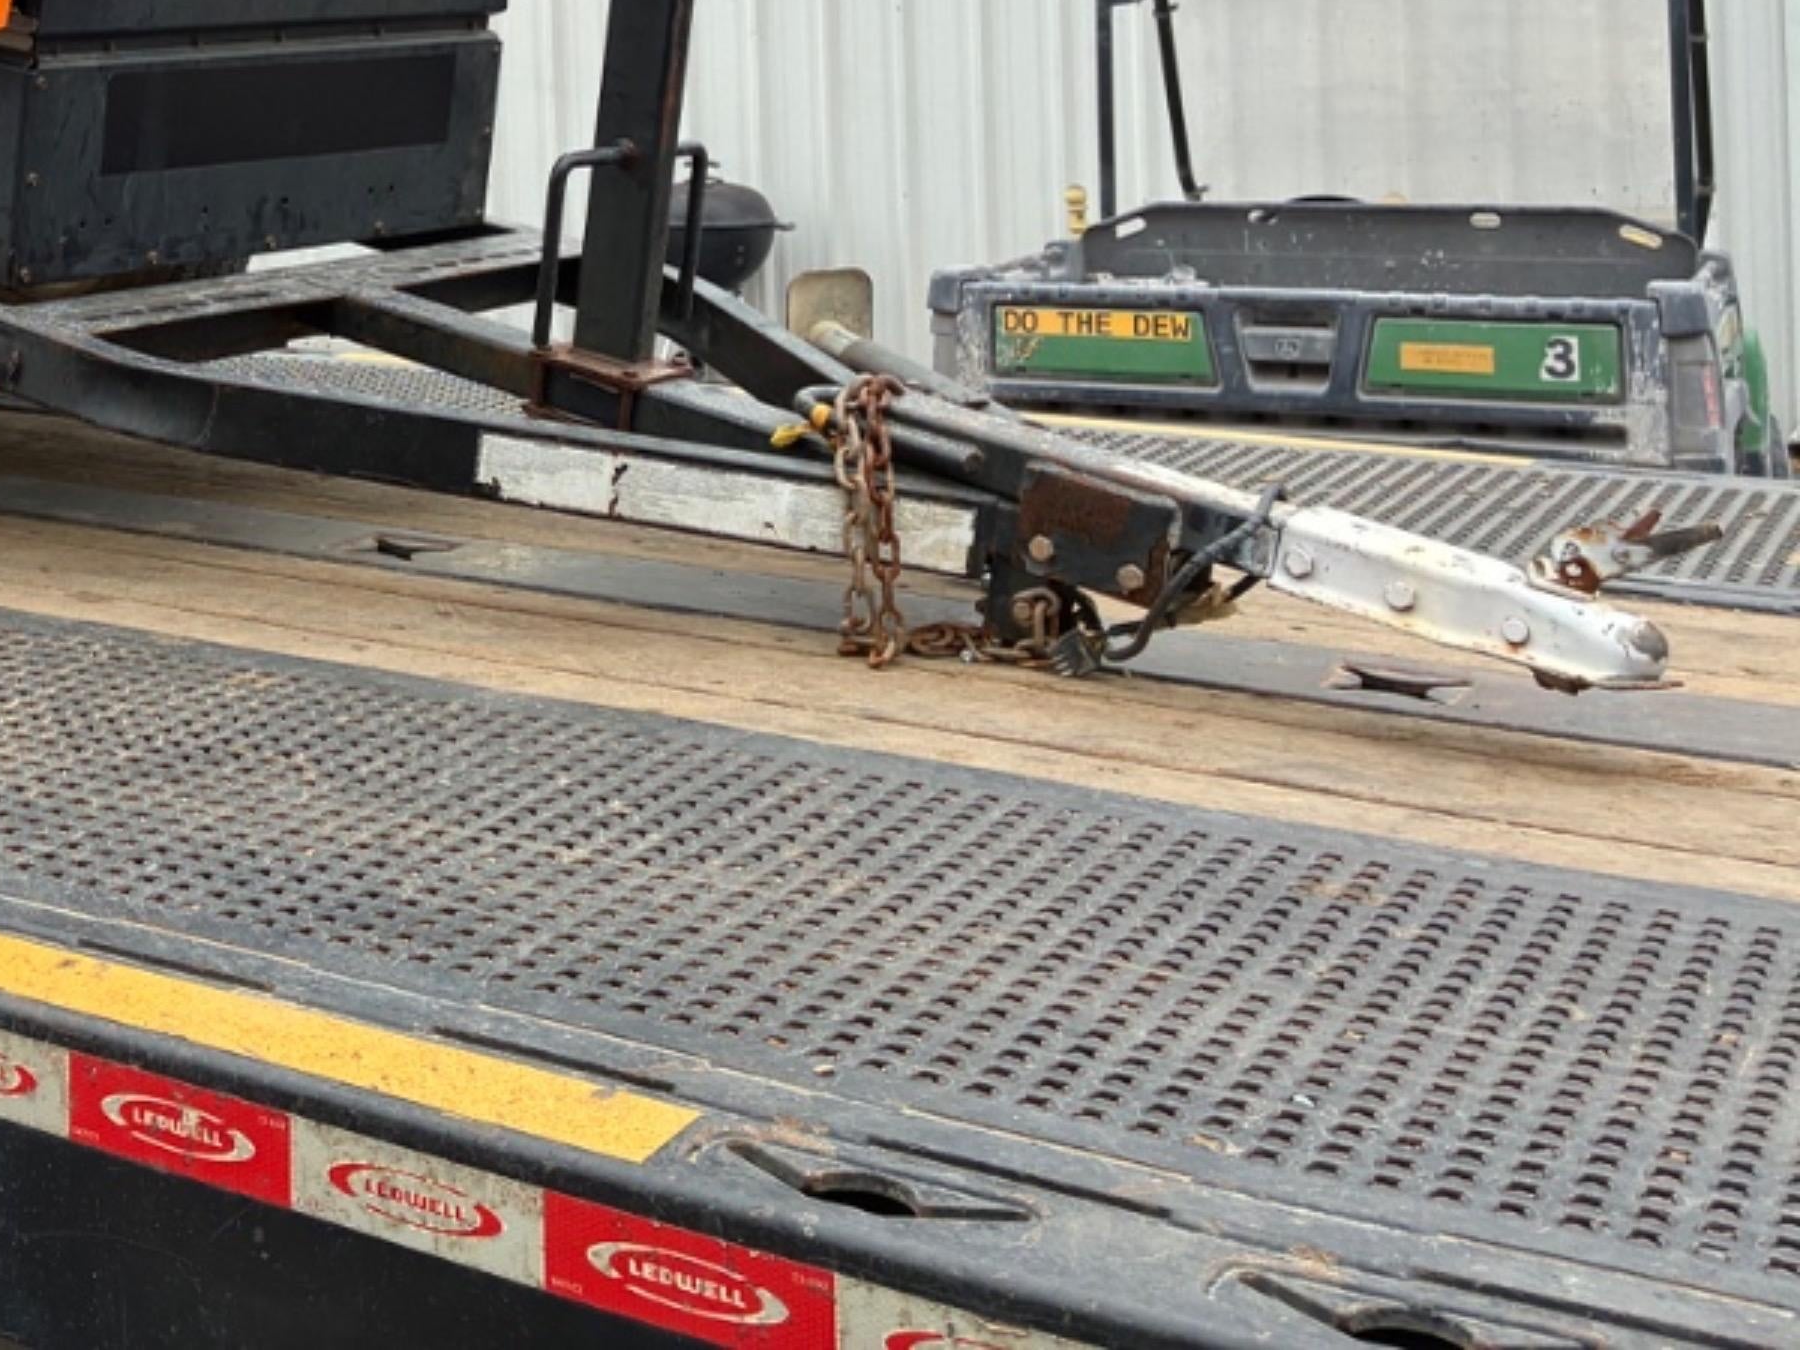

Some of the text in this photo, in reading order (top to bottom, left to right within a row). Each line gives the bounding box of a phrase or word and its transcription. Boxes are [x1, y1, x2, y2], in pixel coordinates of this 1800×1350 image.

[1004, 309, 1189, 338] DO THE DEW
[1544, 337, 1576, 379] 3
[132, 1105, 223, 1149] LEDWELL
[364, 1178, 468, 1223] LEDWELL
[629, 1257, 748, 1309] LEDWELL
